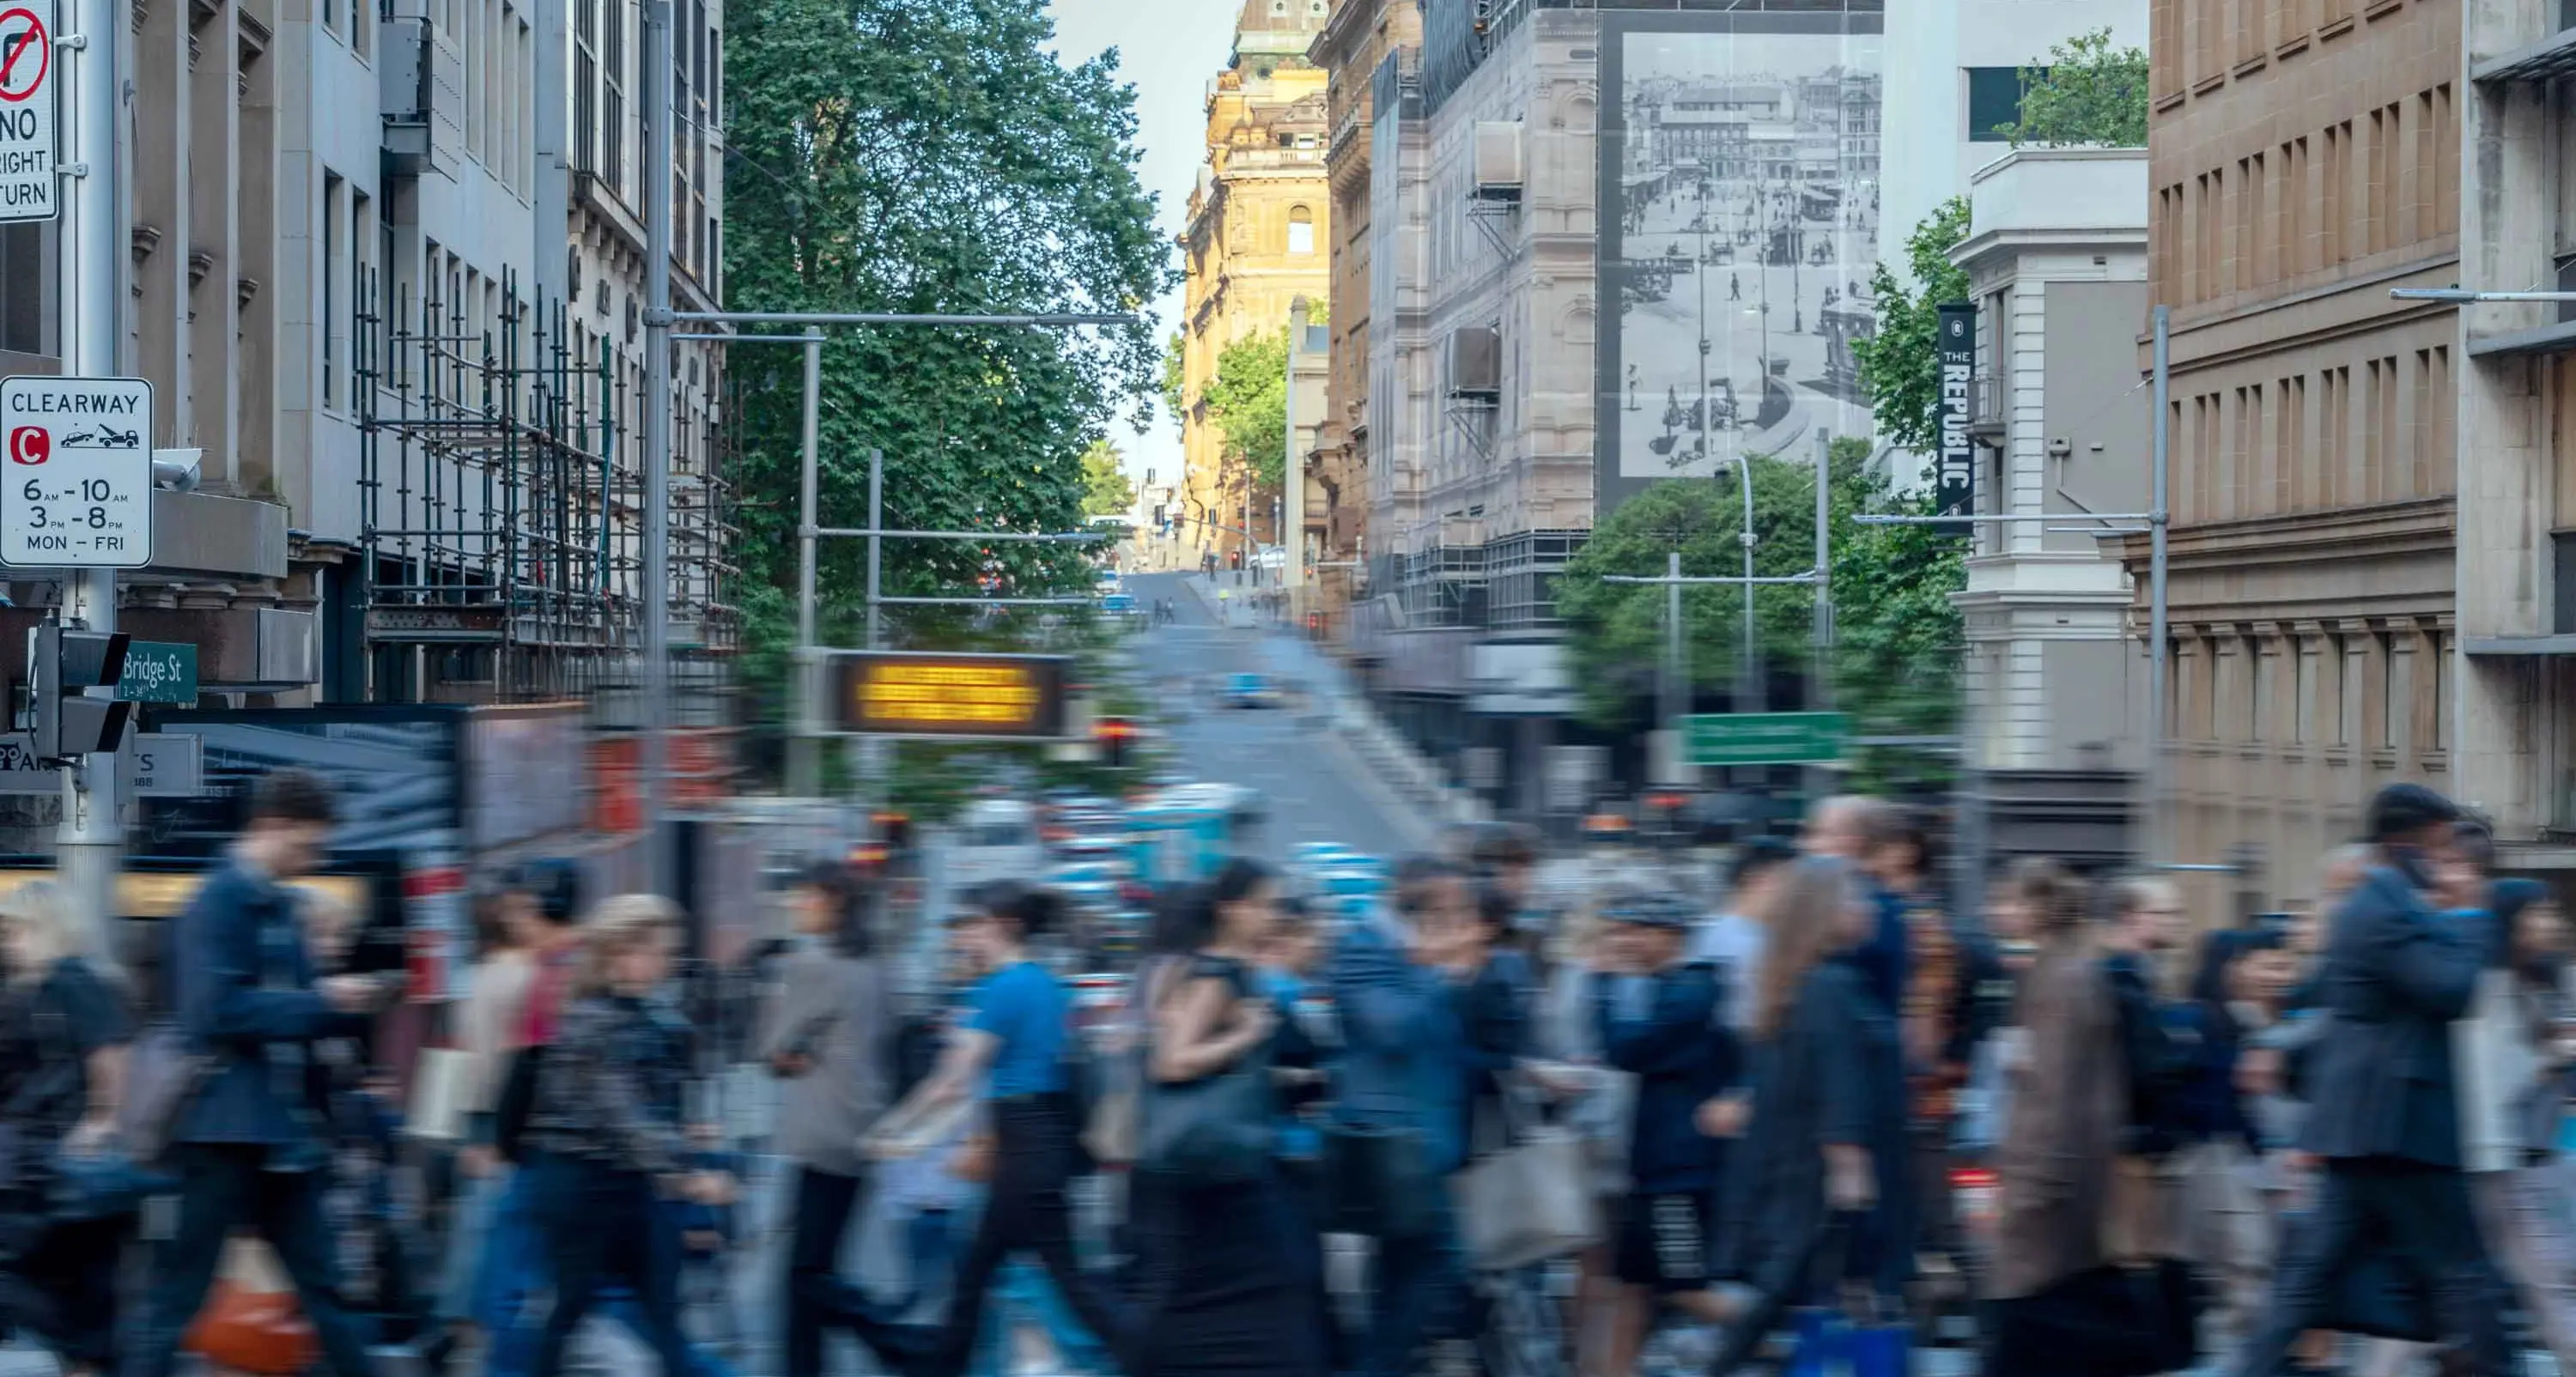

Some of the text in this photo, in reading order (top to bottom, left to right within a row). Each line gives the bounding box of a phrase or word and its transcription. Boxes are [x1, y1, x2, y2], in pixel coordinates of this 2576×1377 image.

[0, 108, 37, 141] NO
[0, 150, 46, 173] IGHT
[1944, 351, 1971, 362] THE
[12, 393, 139, 414] CLEARWAY
[1942, 364, 1971, 488] REPUBLIC
[19, 429, 41, 463] C
[27, 536, 67, 549] MON
[95, 537, 124, 550] FRI
[124, 652, 182, 688] Bridge St
